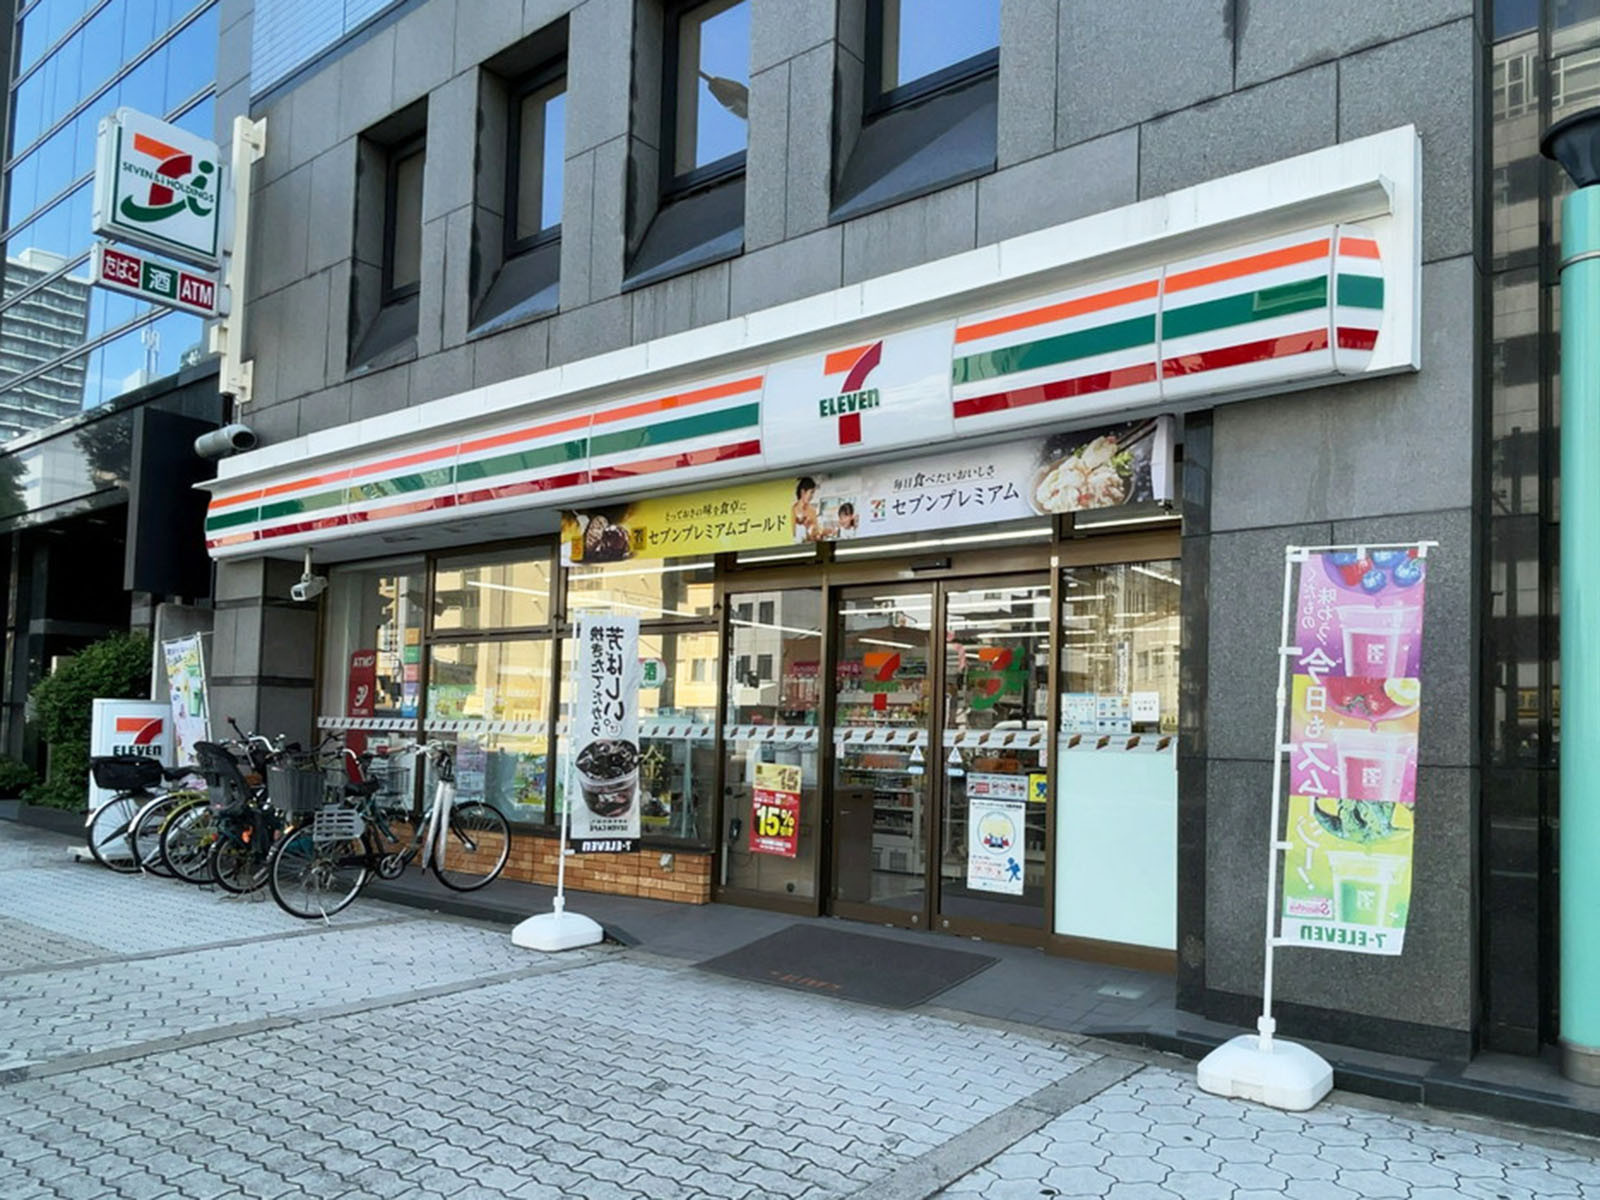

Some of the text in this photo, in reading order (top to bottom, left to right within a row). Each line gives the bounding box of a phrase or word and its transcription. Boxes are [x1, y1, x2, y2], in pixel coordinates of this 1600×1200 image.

[122, 162, 153, 180] SEVEN
[167, 178, 215, 203] HOLDINGS
[103, 256, 139, 283] たばこ
[149, 267, 172, 293] 酒
[181, 279, 213, 305] ATM
[824, 340, 883, 445] 7
[894, 465, 995, 490] 毎日食べたいおいしさ
[892, 482, 1019, 516] セブンプレミアム
[648, 514, 786, 545] セブンプレミアムゴールド
